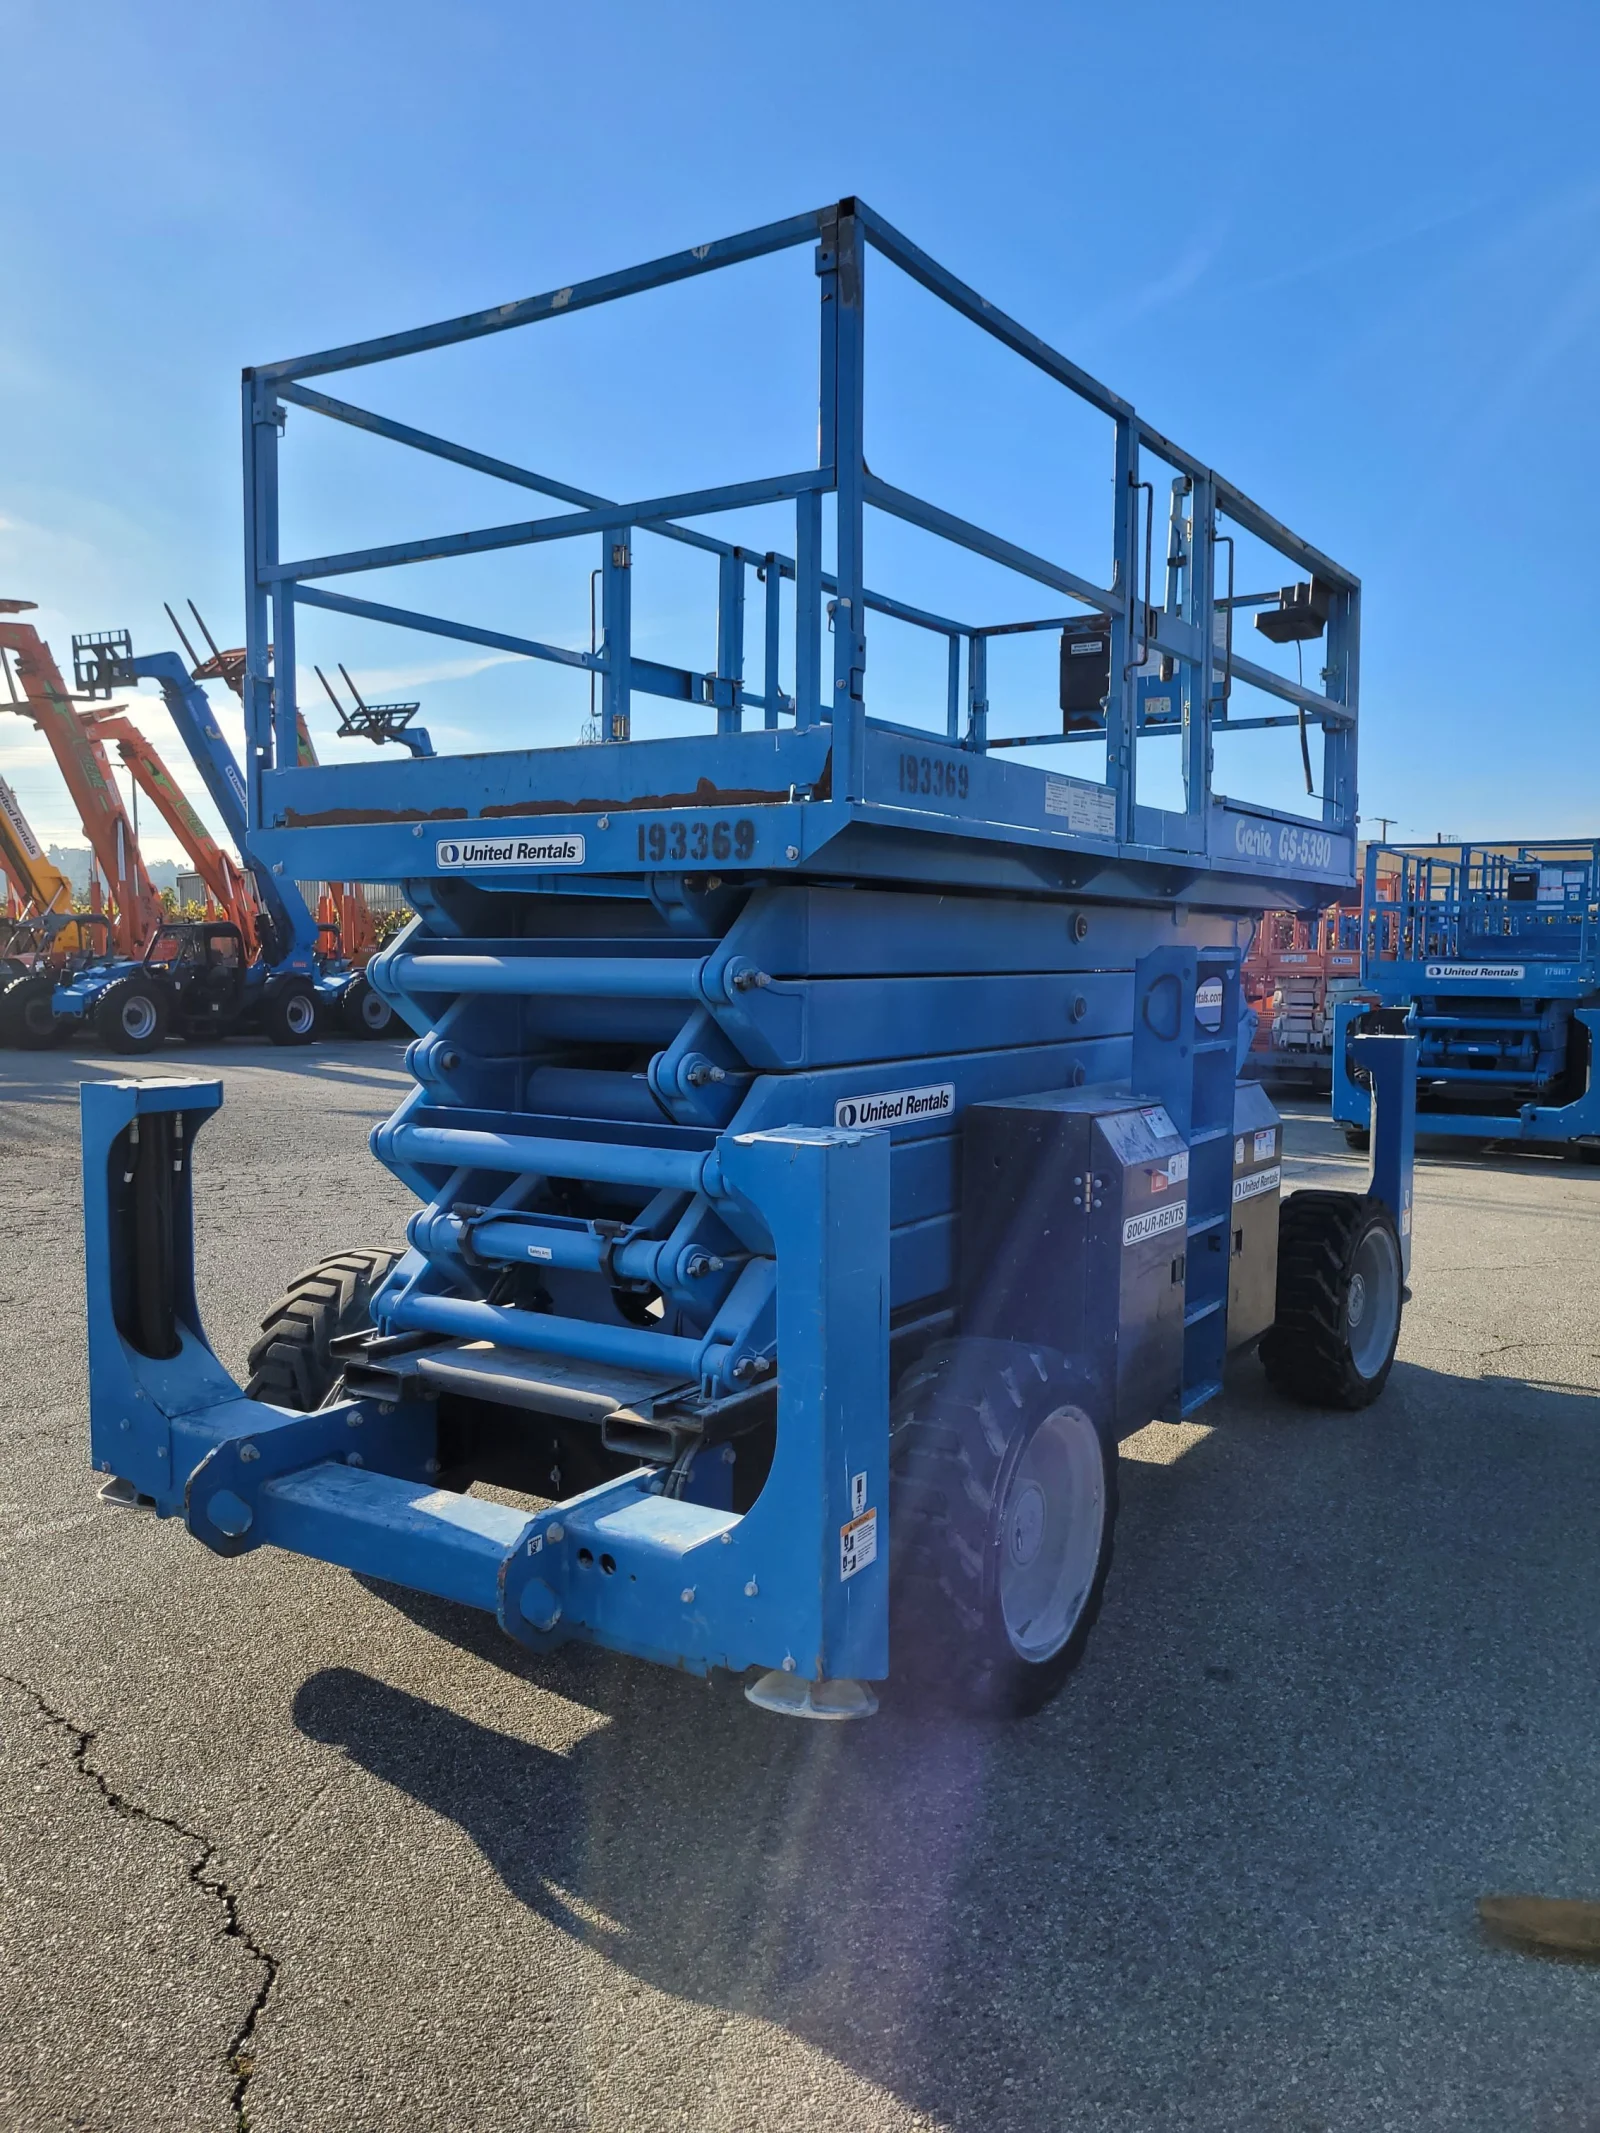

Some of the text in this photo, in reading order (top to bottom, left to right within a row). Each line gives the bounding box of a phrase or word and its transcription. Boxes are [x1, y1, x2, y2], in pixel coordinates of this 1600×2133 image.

[899, 753, 969, 799] 193369
[0, 786, 37, 855] nited Rentals
[463, 841, 576, 861] United Rentals
[637, 819, 756, 862] 193369
[1235, 819, 1331, 868] Genie GS-5390
[1443, 967, 1519, 977] United Rentals
[860, 1090, 949, 1123] United Rentals
[1242, 1171, 1279, 1194] United Rentals
[1127, 1206, 1184, 1240] 800-UR-RENTS
